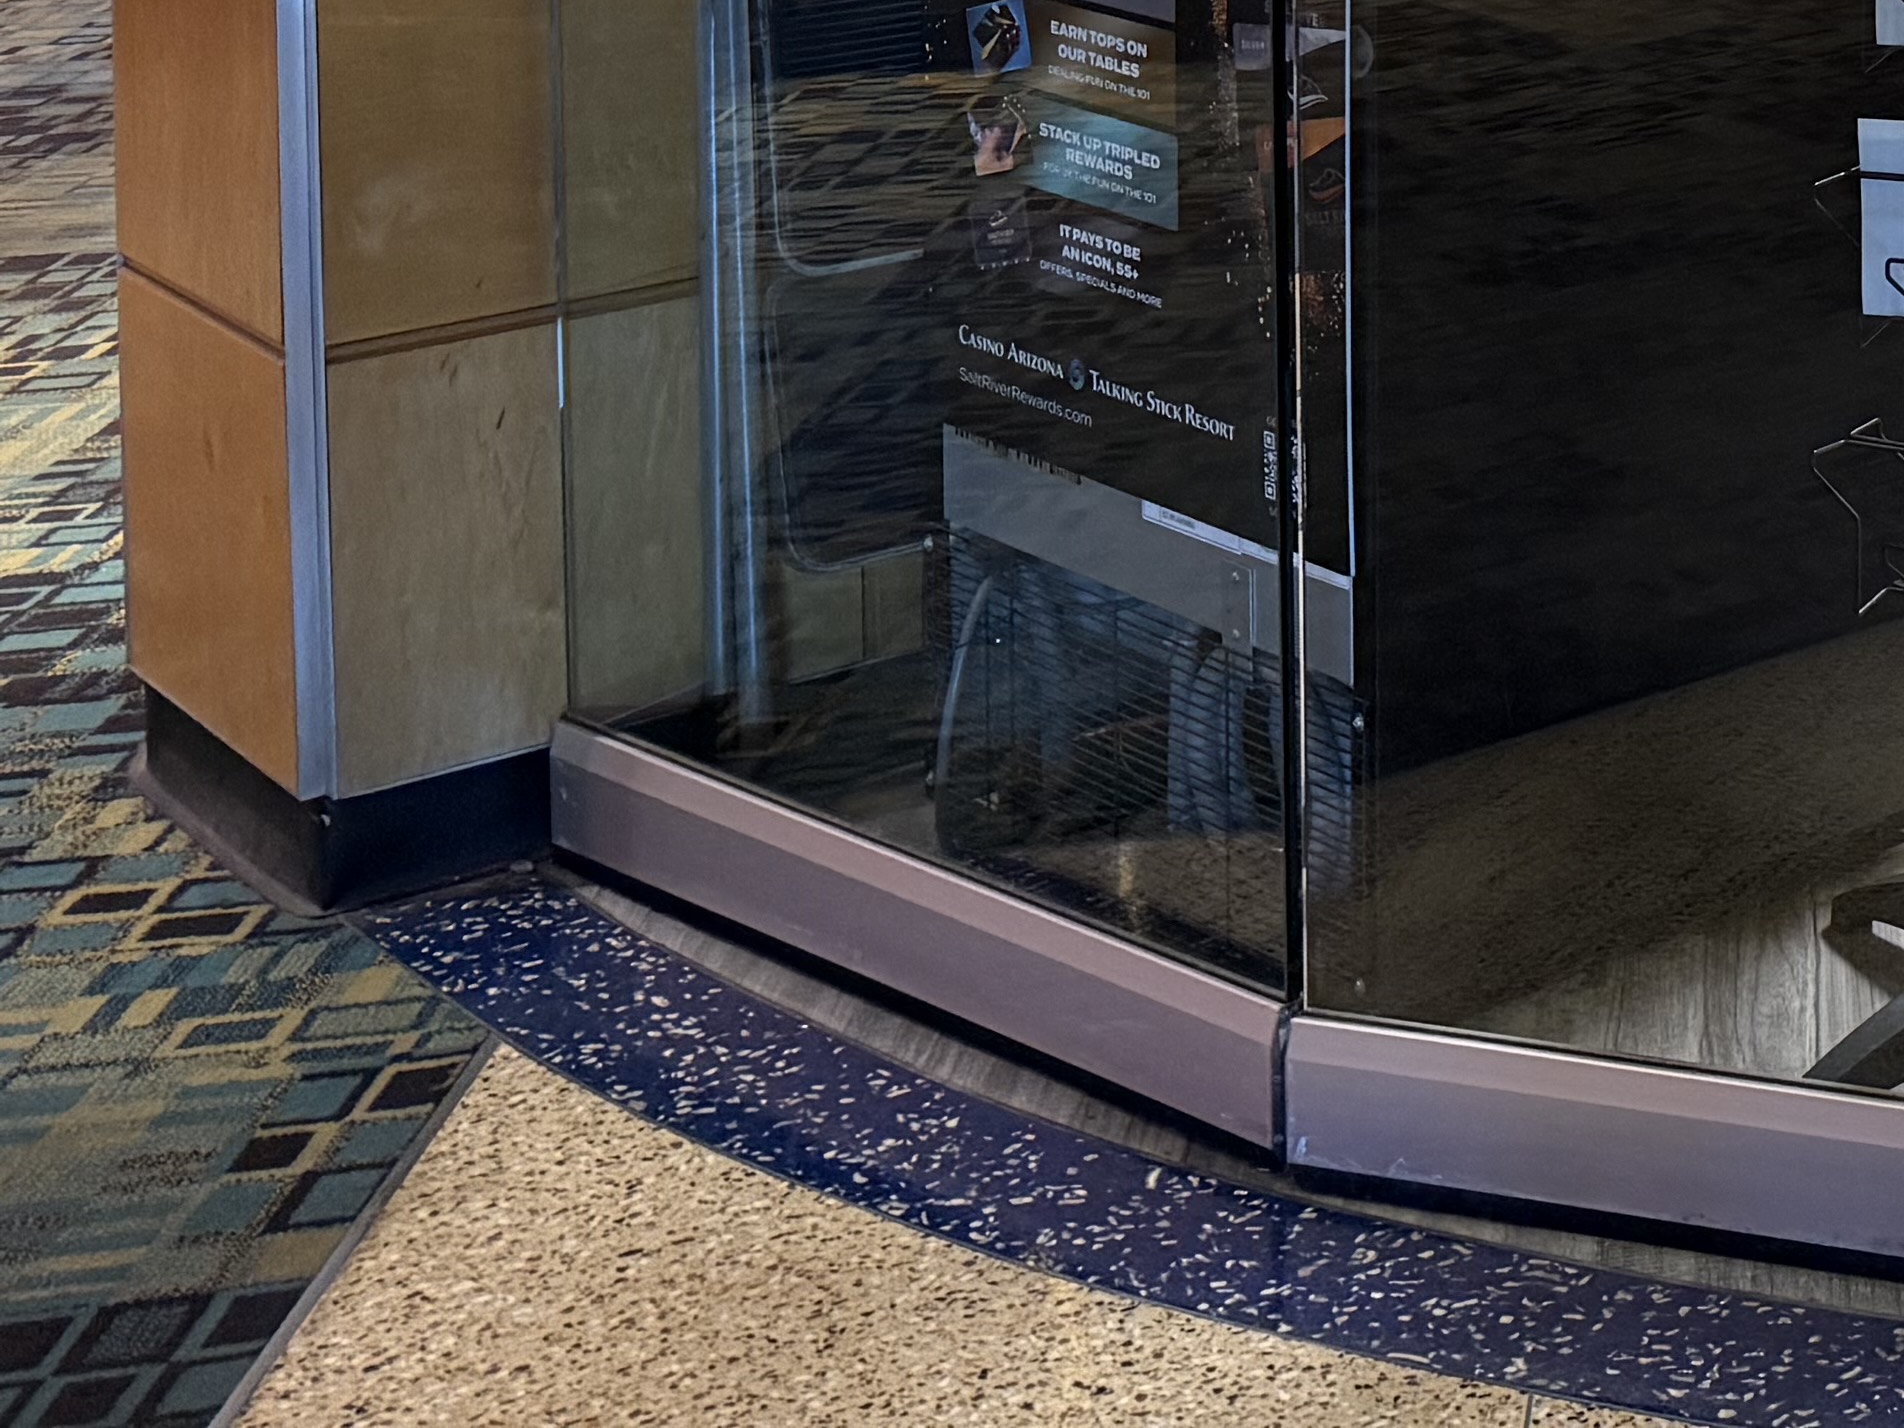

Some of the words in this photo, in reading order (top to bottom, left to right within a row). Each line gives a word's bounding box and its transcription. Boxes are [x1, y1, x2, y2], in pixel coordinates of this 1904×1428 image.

[1050, 19, 1087, 43] EARN
[1089, 29, 1125, 53] TOPS
[1126, 40, 1148, 59] ON
[1058, 43, 1086, 64] OUR
[1088, 51, 1140, 79] TABLES
[1104, 78, 1118, 93] ON
[1118, 82, 1136, 98] THE
[1136, 87, 1151, 101] 101
[1039, 123, 1081, 146] STACK
[1083, 133, 1101, 151] UP
[1103, 140, 1161, 169] TRIPLED
[1065, 148, 1134, 181] REWARDS
[1124, 185, 1142, 202] THE
[1143, 190, 1157, 205] 101
[1059, 224, 1071, 240] IT
[1072, 227, 1105, 250] PAYS
[1104, 238, 1123, 254] TO
[1123, 243, 1141, 262] BE
[1061, 245, 1080, 263] AN
[1081, 250, 1115, 276] ICON,
[1116, 283, 1136, 301] AND
[1136, 290, 1163, 309] MORE
[958, 366, 1093, 429] SaltRiverRewards.com
[1007, 342, 1064, 380] ARIZONA
[1089, 368, 1143, 408] TALKING
[1146, 390, 1182, 424] STICK
[1185, 404, 1236, 441] RESORT
